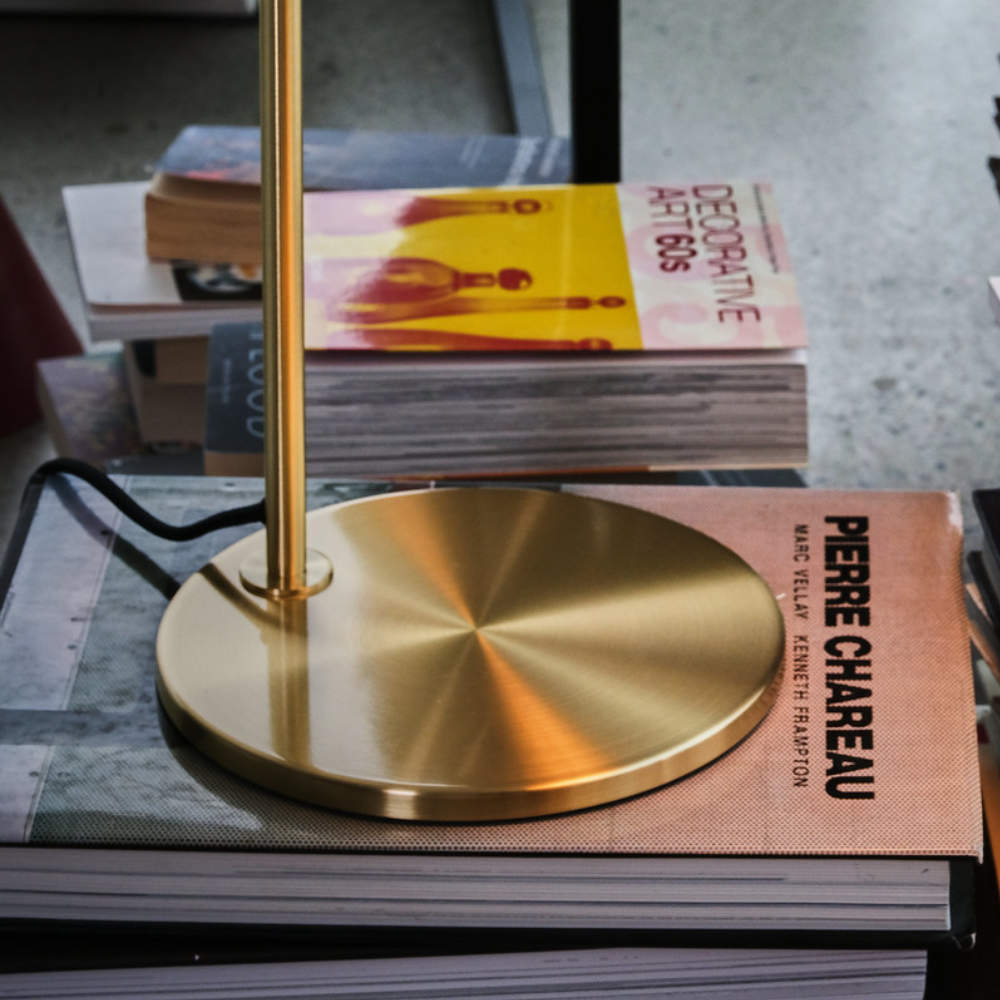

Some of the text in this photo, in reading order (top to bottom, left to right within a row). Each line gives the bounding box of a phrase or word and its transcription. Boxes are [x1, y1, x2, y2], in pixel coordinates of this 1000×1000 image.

[648, 185, 693, 231] ART
[692, 184, 761, 322] DECORATIVE
[793, 523, 810, 789] MARC VELLAY KENNETH FRAMPTON
[823, 515, 875, 800] PIERRE CHAREAU
